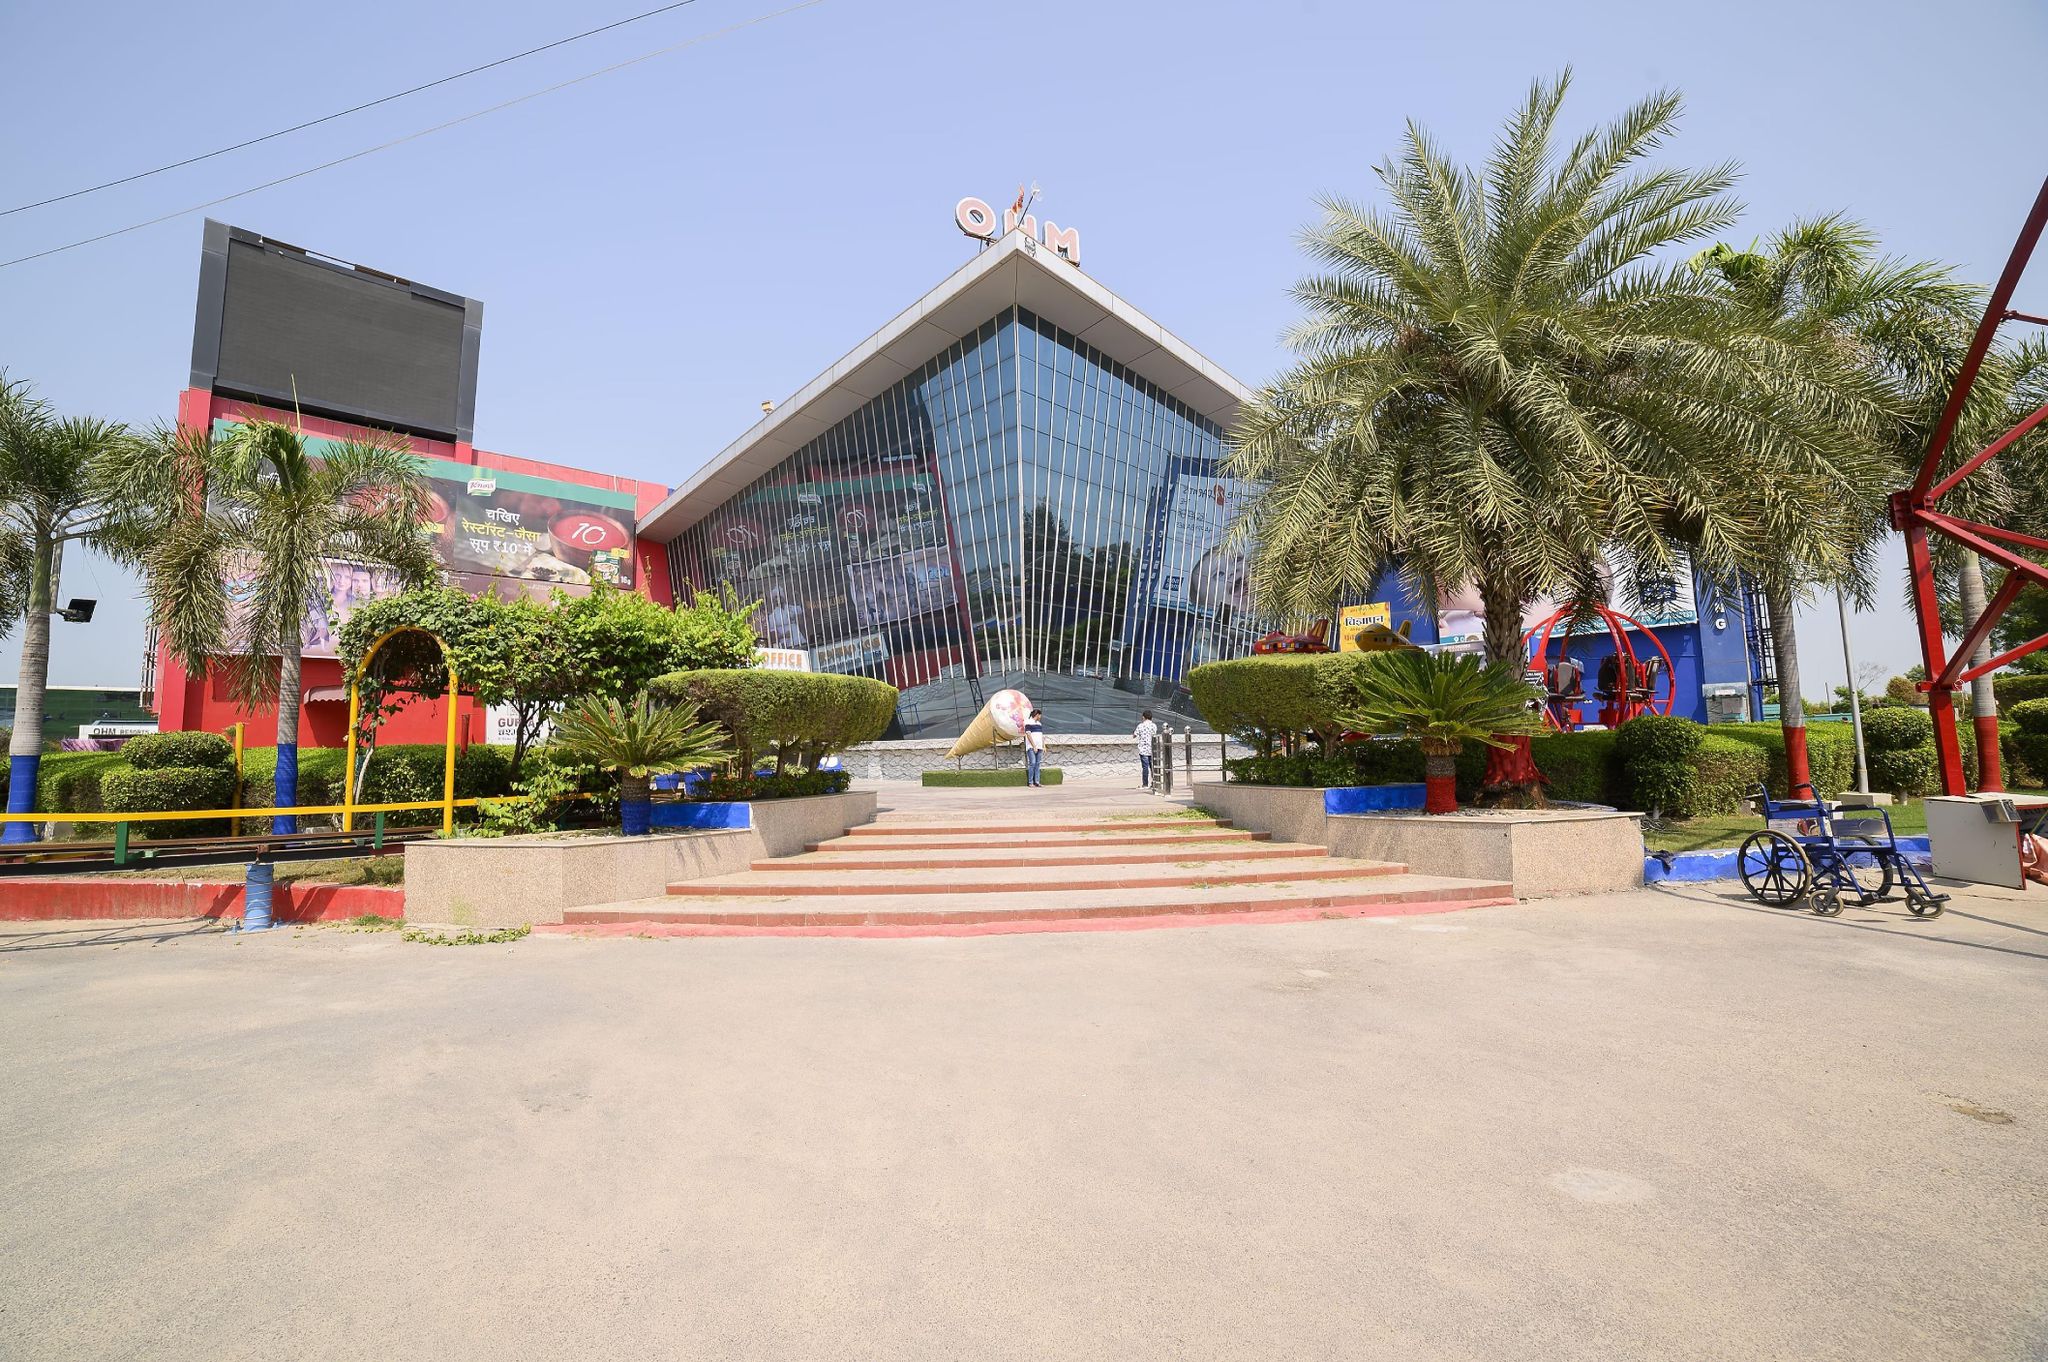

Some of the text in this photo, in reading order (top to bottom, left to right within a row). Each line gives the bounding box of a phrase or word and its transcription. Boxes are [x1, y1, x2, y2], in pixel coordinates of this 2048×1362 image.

[485, 508, 520, 525] चखिए
[572, 522, 606, 545] 10
[469, 537, 491, 555] सूप
